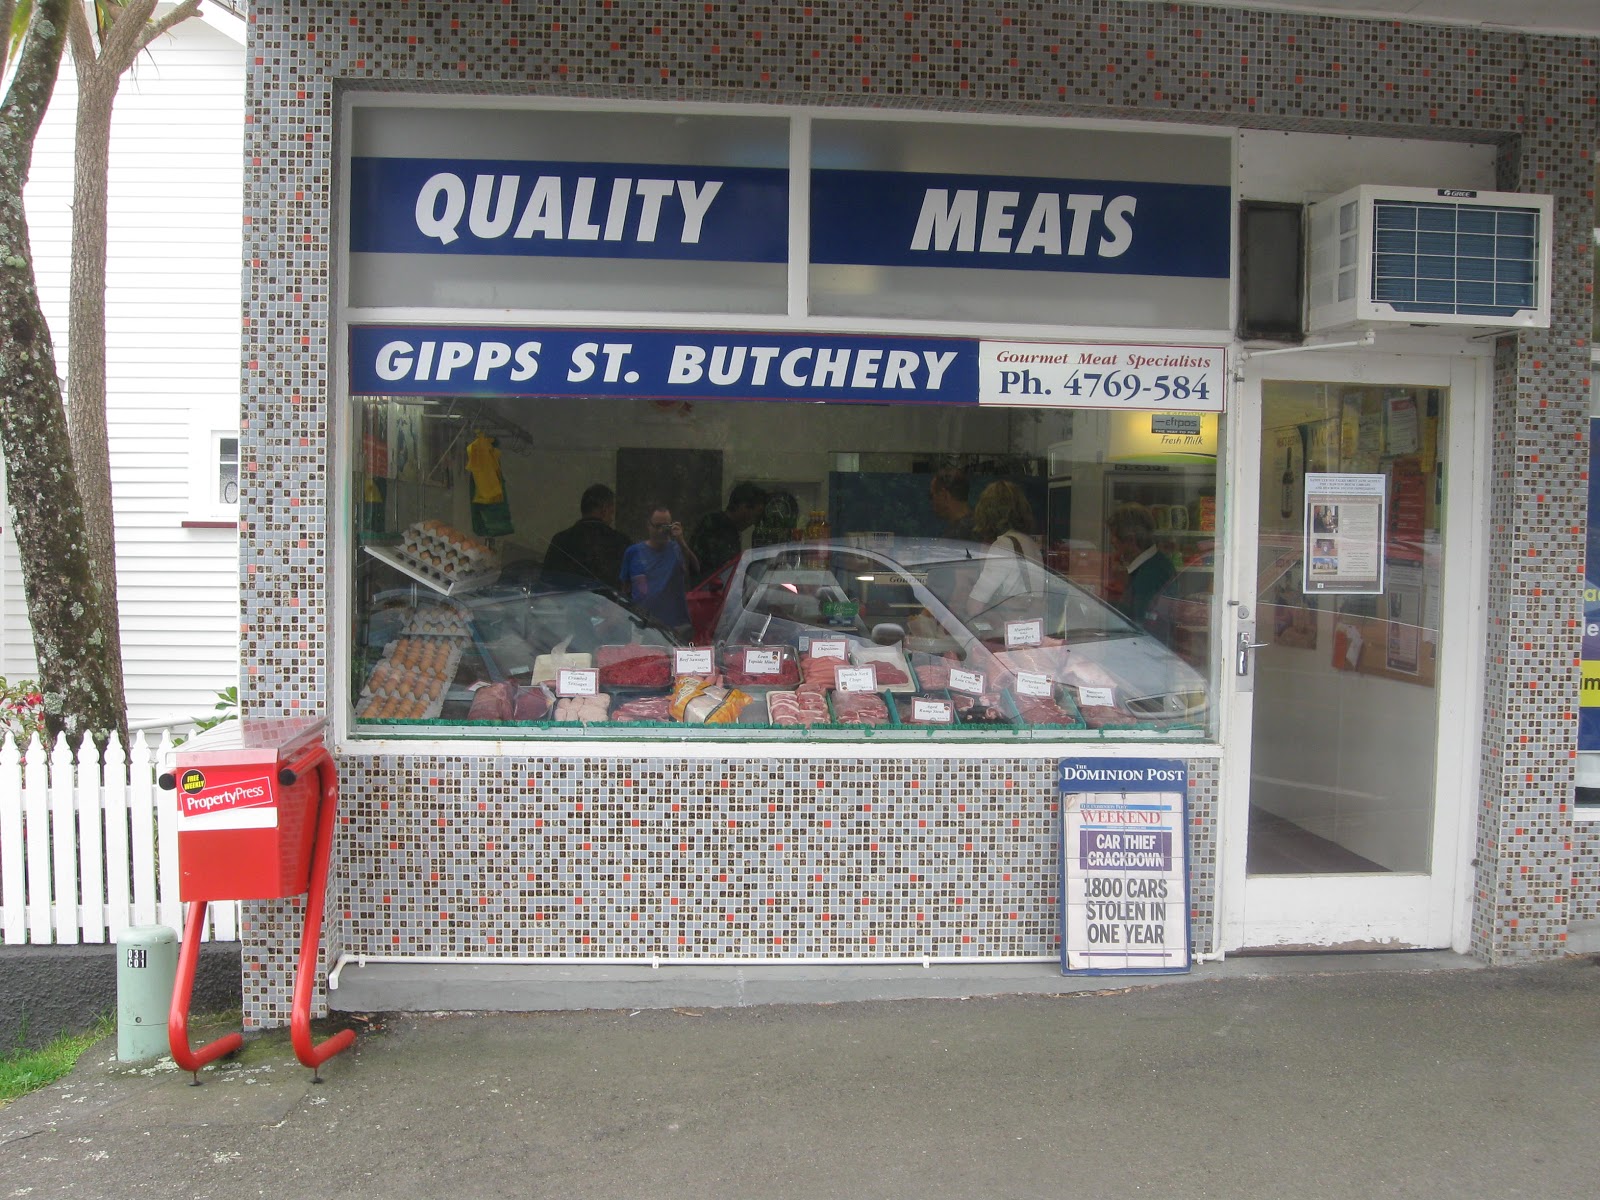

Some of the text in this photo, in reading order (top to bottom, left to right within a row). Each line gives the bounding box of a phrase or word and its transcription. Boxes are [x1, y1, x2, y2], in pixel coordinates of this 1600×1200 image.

[415, 172, 724, 246] QUALITY
[909, 188, 1138, 258] MEATS
[375, 340, 959, 391] GIPPS ST. BUTCHERY
[996, 350, 1212, 369] Gourmet Meat Specialists
[999, 369, 1211, 402] Ph. 4769-584
[1165, 417, 1197, 428] eftpos
[1161, 435, 1204, 445] Fresh Milk
[187, 774, 200, 783] FREE
[1064, 766, 1185, 782] DOMINION POST
[184, 780, 205, 791] WEEKLY
[186, 786, 265, 811] PropertyPress
[1080, 810, 1161, 824] WEEKEND
[1096, 833, 1157, 850] CAR THIEF
[1087, 851, 1165, 868] CRACKDOWN
[1084, 877, 1168, 898] 1800 CARS
[1086, 900, 1167, 921] STOLEN IN
[1087, 923, 1165, 944] ONE YEAR
[128, 949, 145, 959] 031
